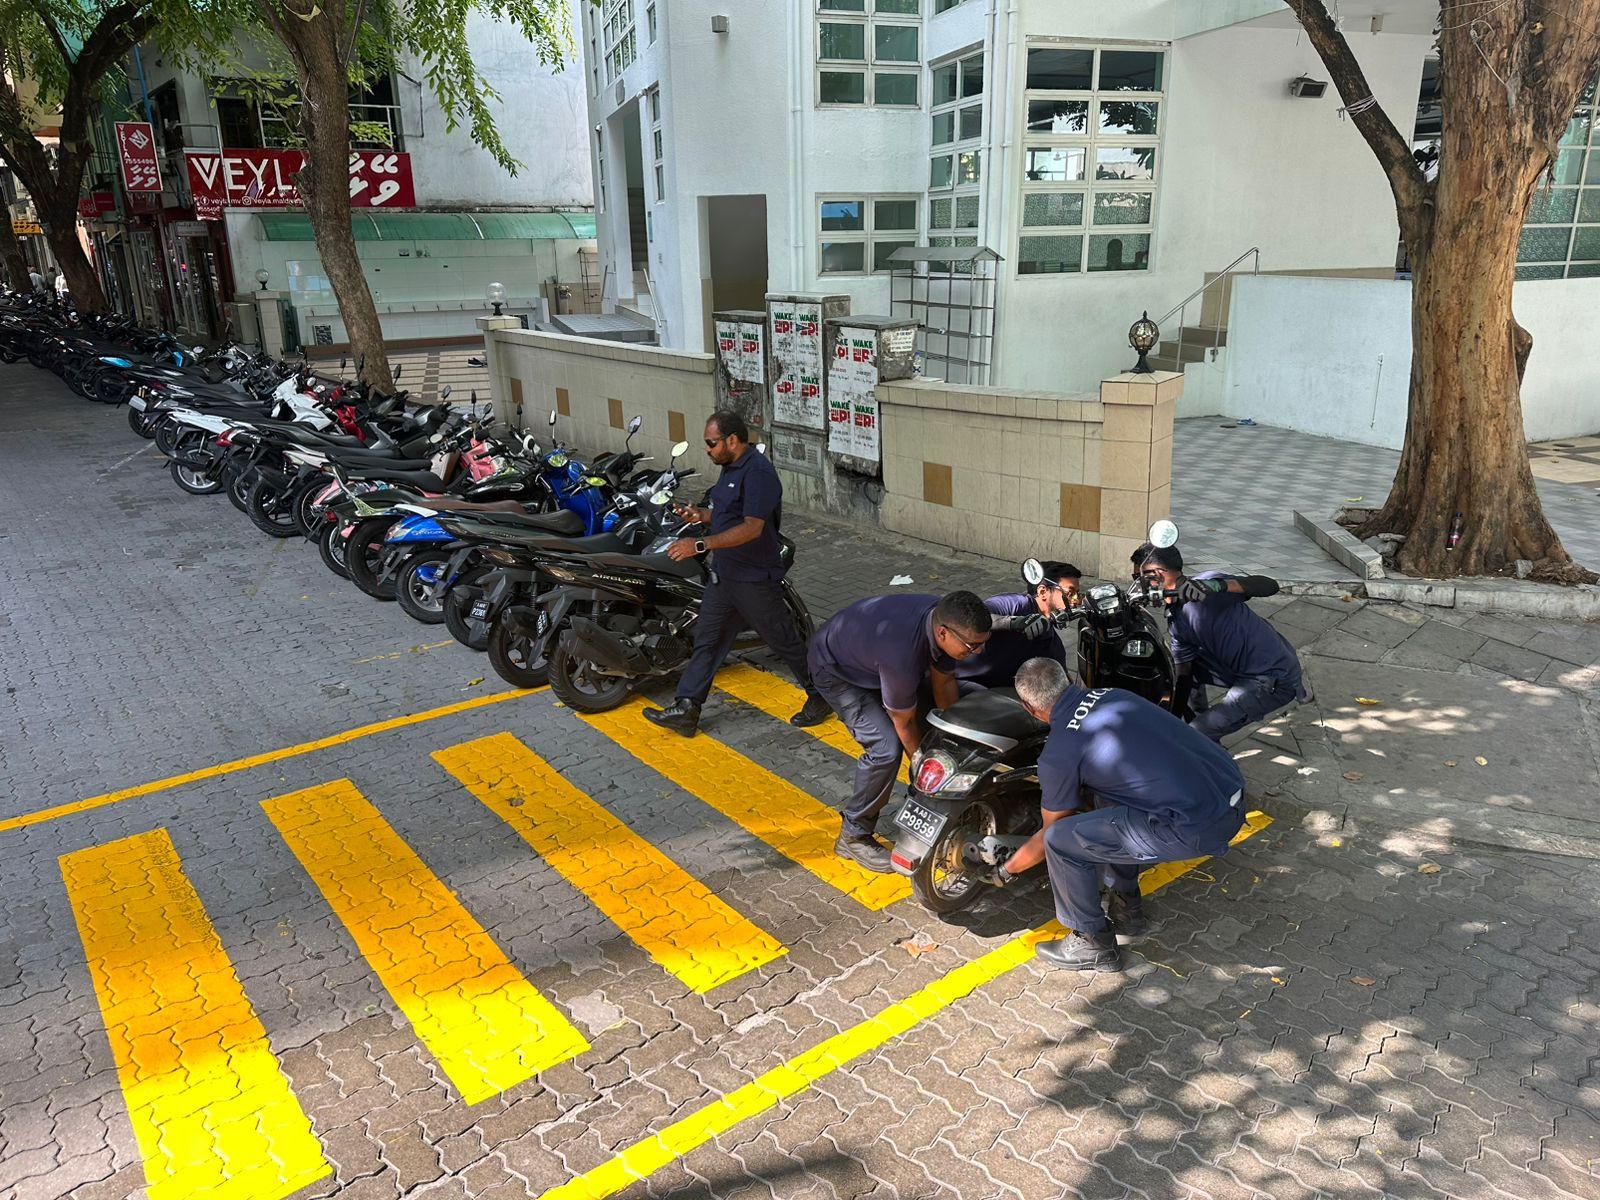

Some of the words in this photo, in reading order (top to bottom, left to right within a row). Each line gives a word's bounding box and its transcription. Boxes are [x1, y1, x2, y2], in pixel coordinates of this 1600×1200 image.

[190, 157, 306, 191] VEYL
[773, 311, 793, 320] WAKE
[799, 313, 819, 322] WAKE
[719, 331, 736, 339] WAKE
[742, 332, 759, 341] WAKE
[852, 339, 873, 349] WAKE
[837, 346, 849, 360] P!
[801, 375, 819, 385] WAKE
[830, 400, 850, 410] WAKE
[854, 404, 874, 415] WAKE
[900, 809, 935, 838] P9859
